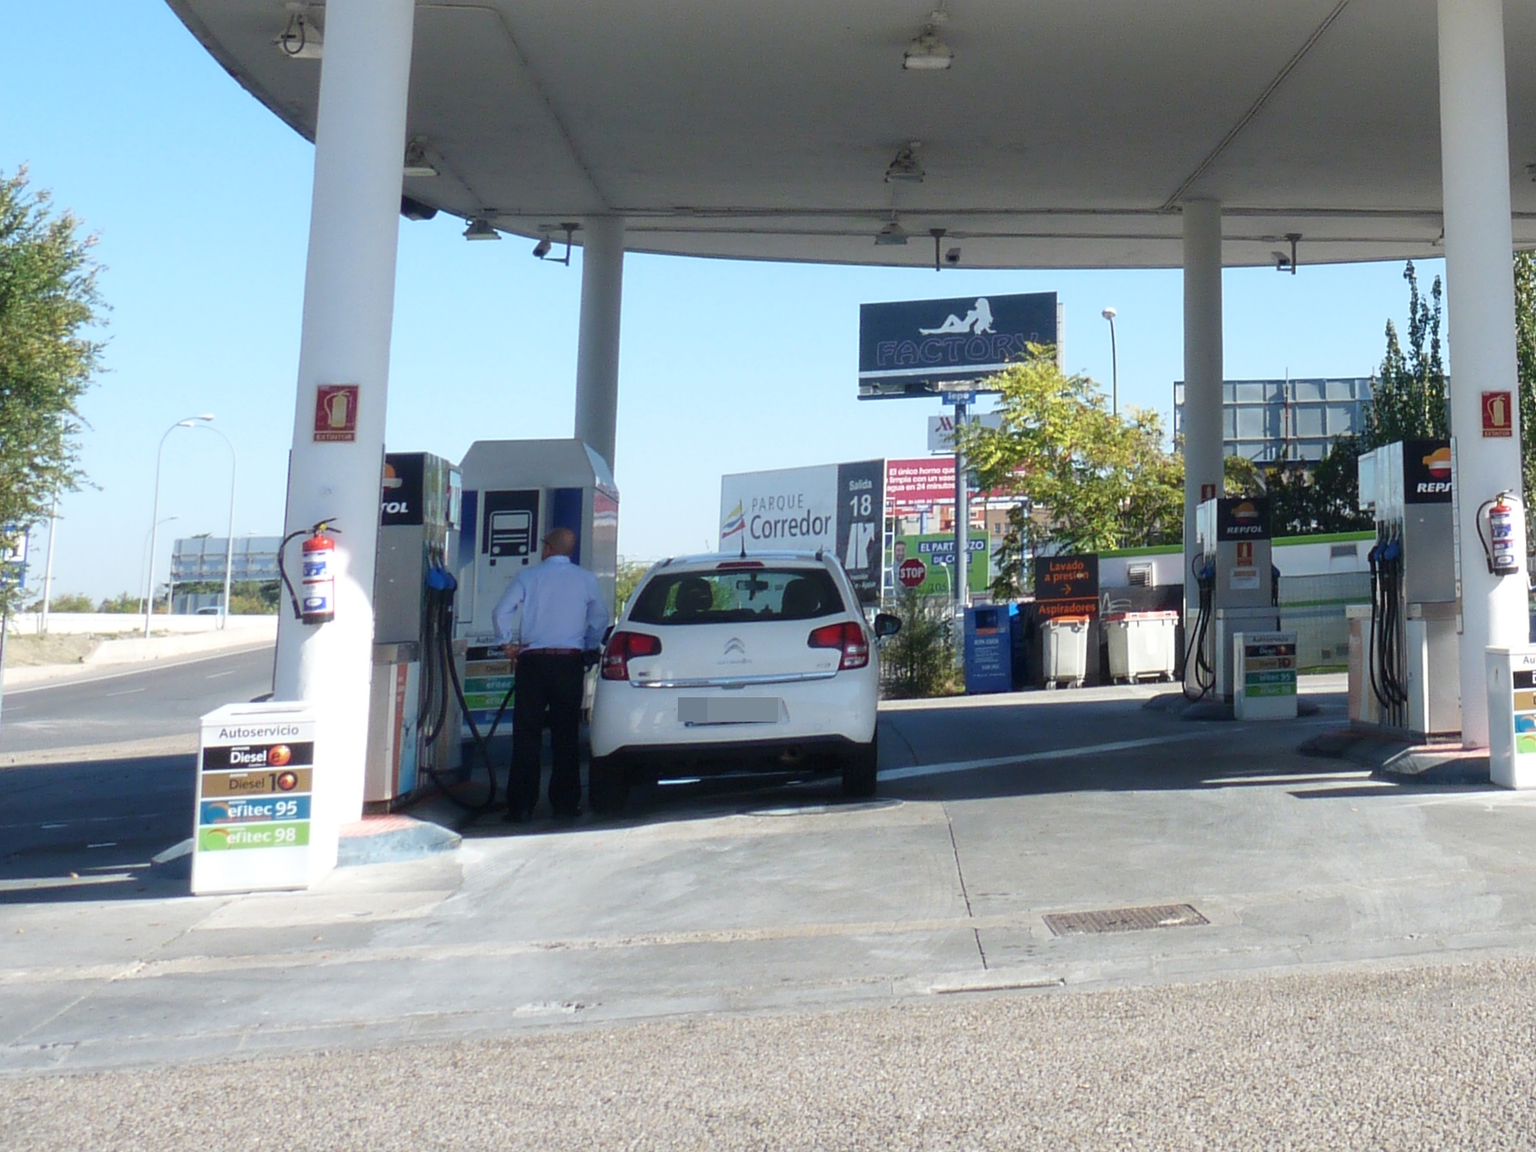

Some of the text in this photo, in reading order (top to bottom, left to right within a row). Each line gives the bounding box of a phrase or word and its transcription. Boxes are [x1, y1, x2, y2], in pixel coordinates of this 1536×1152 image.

[849, 478, 872, 491] Salida
[1417, 482, 1452, 493] REPS
[751, 493, 804, 512] PARQUE
[849, 494, 872, 517] 18
[751, 509, 831, 540] Corredor
[1226, 525, 1263, 534] REPSOL
[920, 544, 931, 552] EL
[1049, 561, 1084, 571] Lavado
[900, 567, 925, 579] STOP
[1053, 570, 1089, 583] presión
[1038, 603, 1096, 615] Aspiradores
[219, 725, 299, 738] Autoservicio
[230, 750, 267, 764] Diesel
[229, 771, 298, 792] Diesel 10
[228, 800, 298, 818] efitec 95
[227, 827, 296, 844] efitec 98
